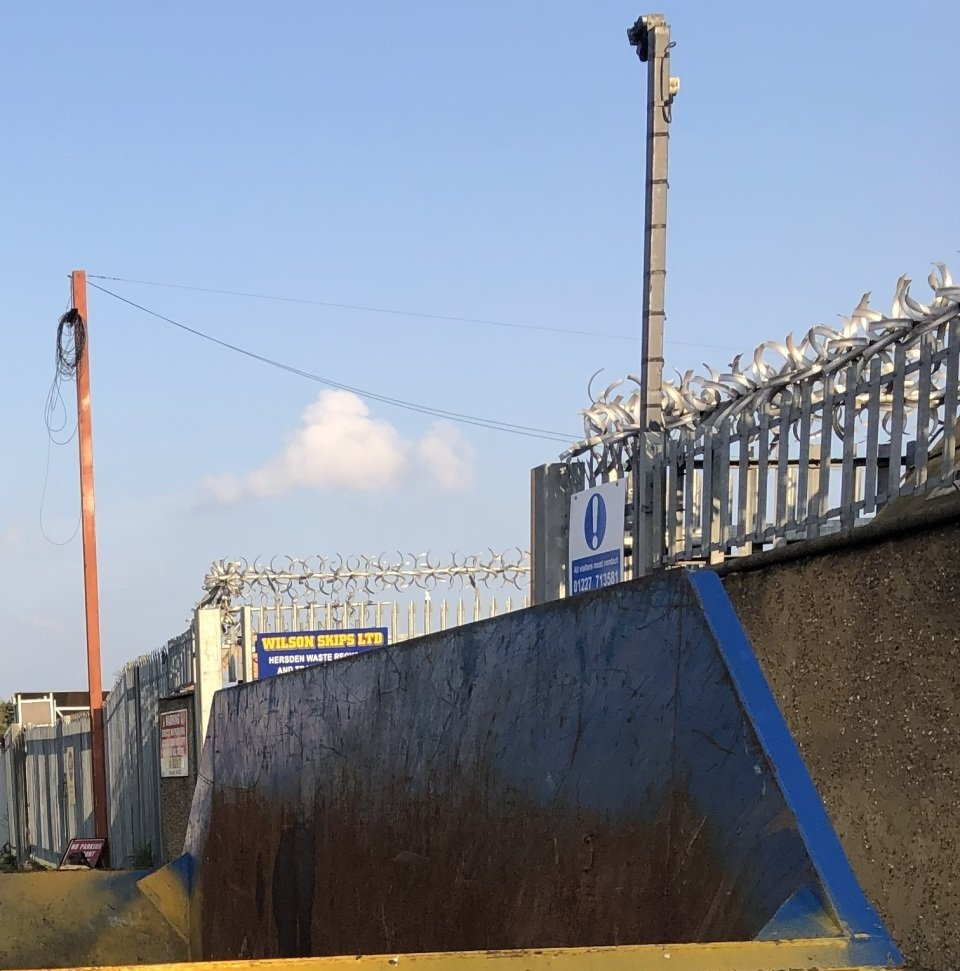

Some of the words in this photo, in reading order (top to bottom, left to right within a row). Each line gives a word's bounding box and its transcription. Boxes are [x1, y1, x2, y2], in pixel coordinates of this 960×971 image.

[573, 576, 592, 593] 01227
[596, 570, 618, 588] 713581
[261, 635, 316, 652] WILSON
[317, 633, 356, 648] SKIPS
[357, 632, 384, 646] LTD
[268, 654, 305, 665] HERSDEN
[306, 653, 333, 663] WASTE
